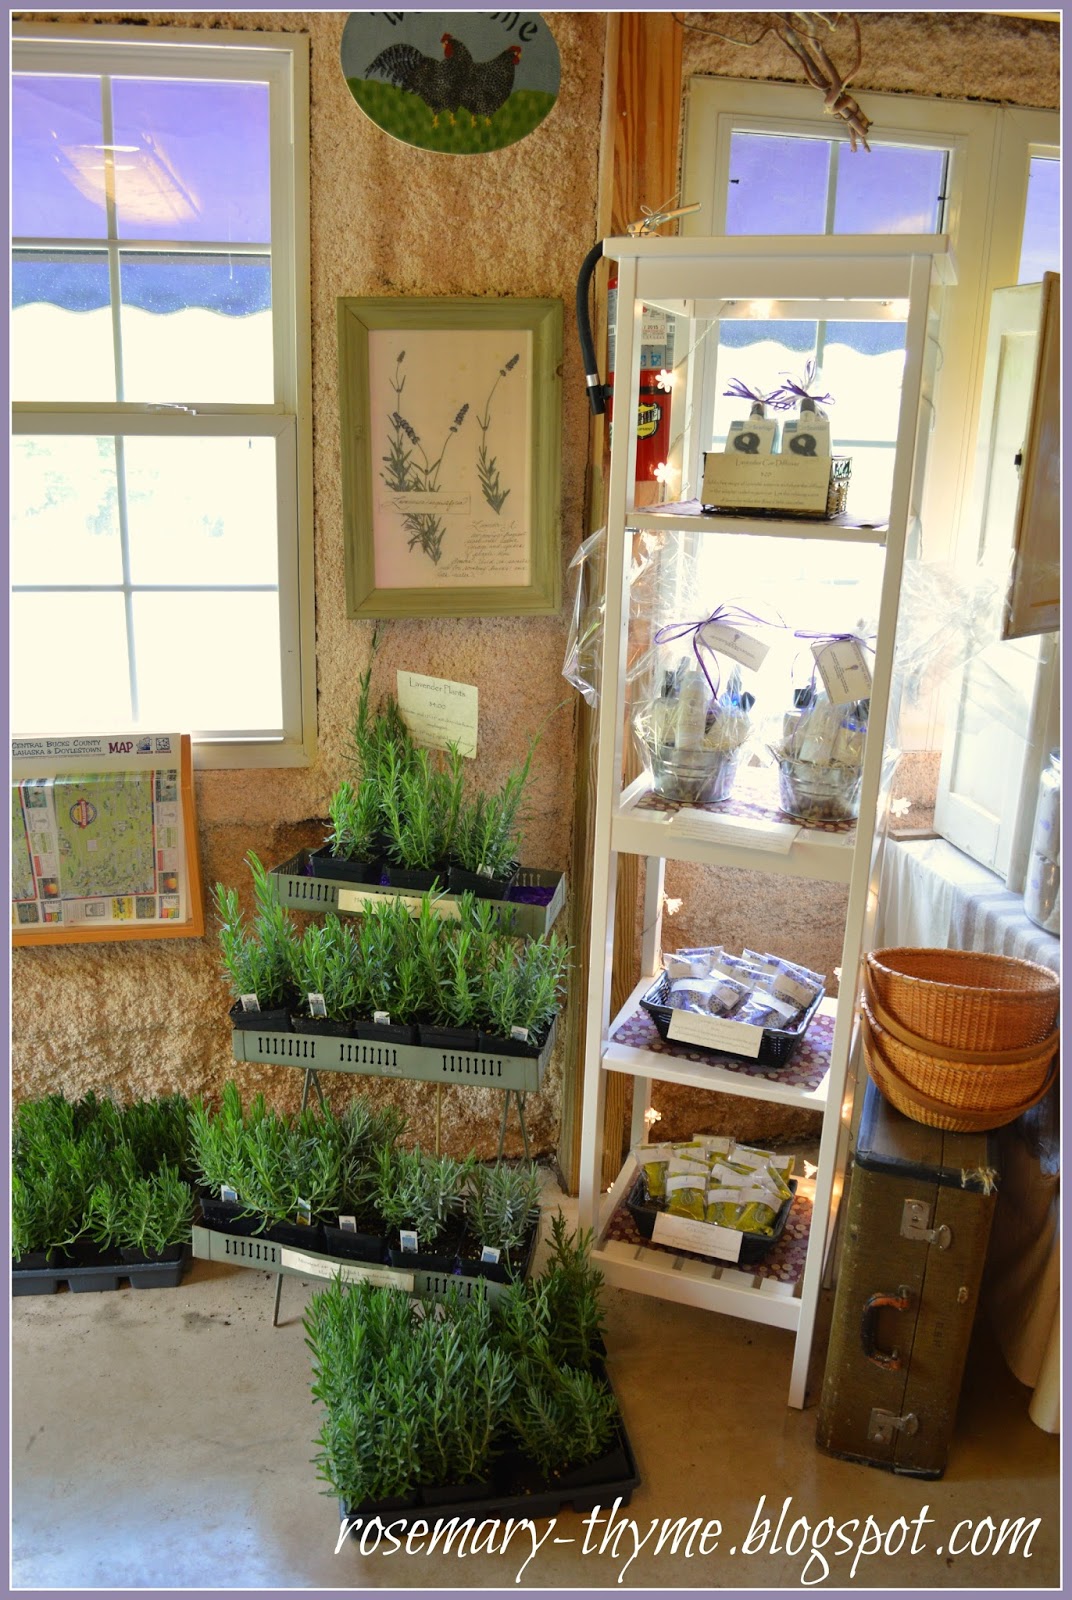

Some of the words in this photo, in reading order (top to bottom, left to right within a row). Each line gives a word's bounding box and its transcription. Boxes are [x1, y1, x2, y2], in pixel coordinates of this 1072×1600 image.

[409, 676, 442, 692] Lavender
[444, 684, 466, 697] Plants
[12, 741, 43, 749] CENTRAL
[46, 740, 70, 748] BUCKS
[73, 739, 101, 747] COUNTY
[108, 741, 134, 754] MAP
